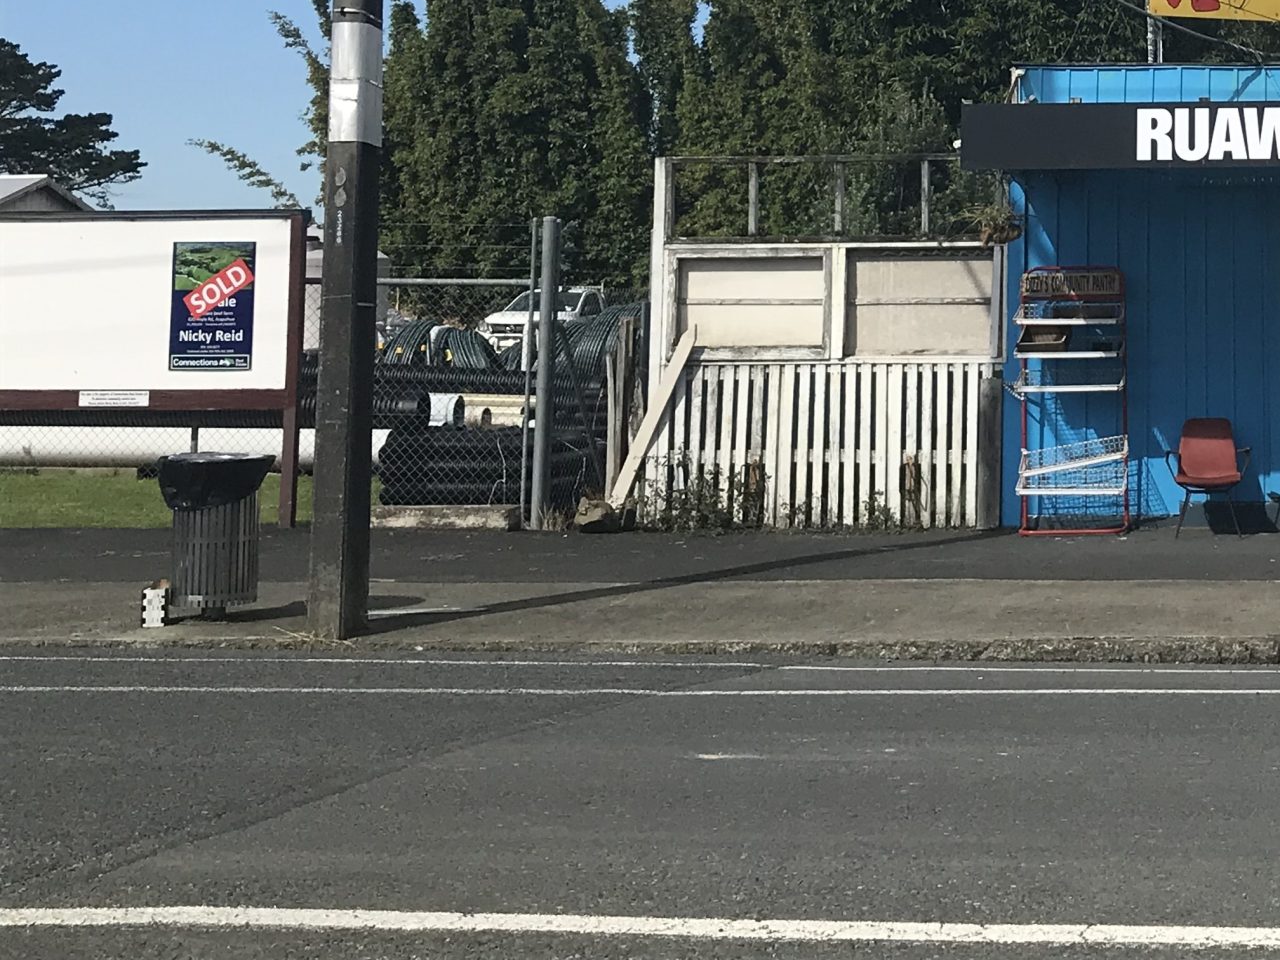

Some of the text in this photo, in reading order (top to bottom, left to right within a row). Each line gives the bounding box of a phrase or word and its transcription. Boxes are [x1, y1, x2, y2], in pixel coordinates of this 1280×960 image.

[190, 266, 247, 313] SOLD
[179, 330, 244, 344] Nicky Reid
[173, 358, 218, 367] Connections
